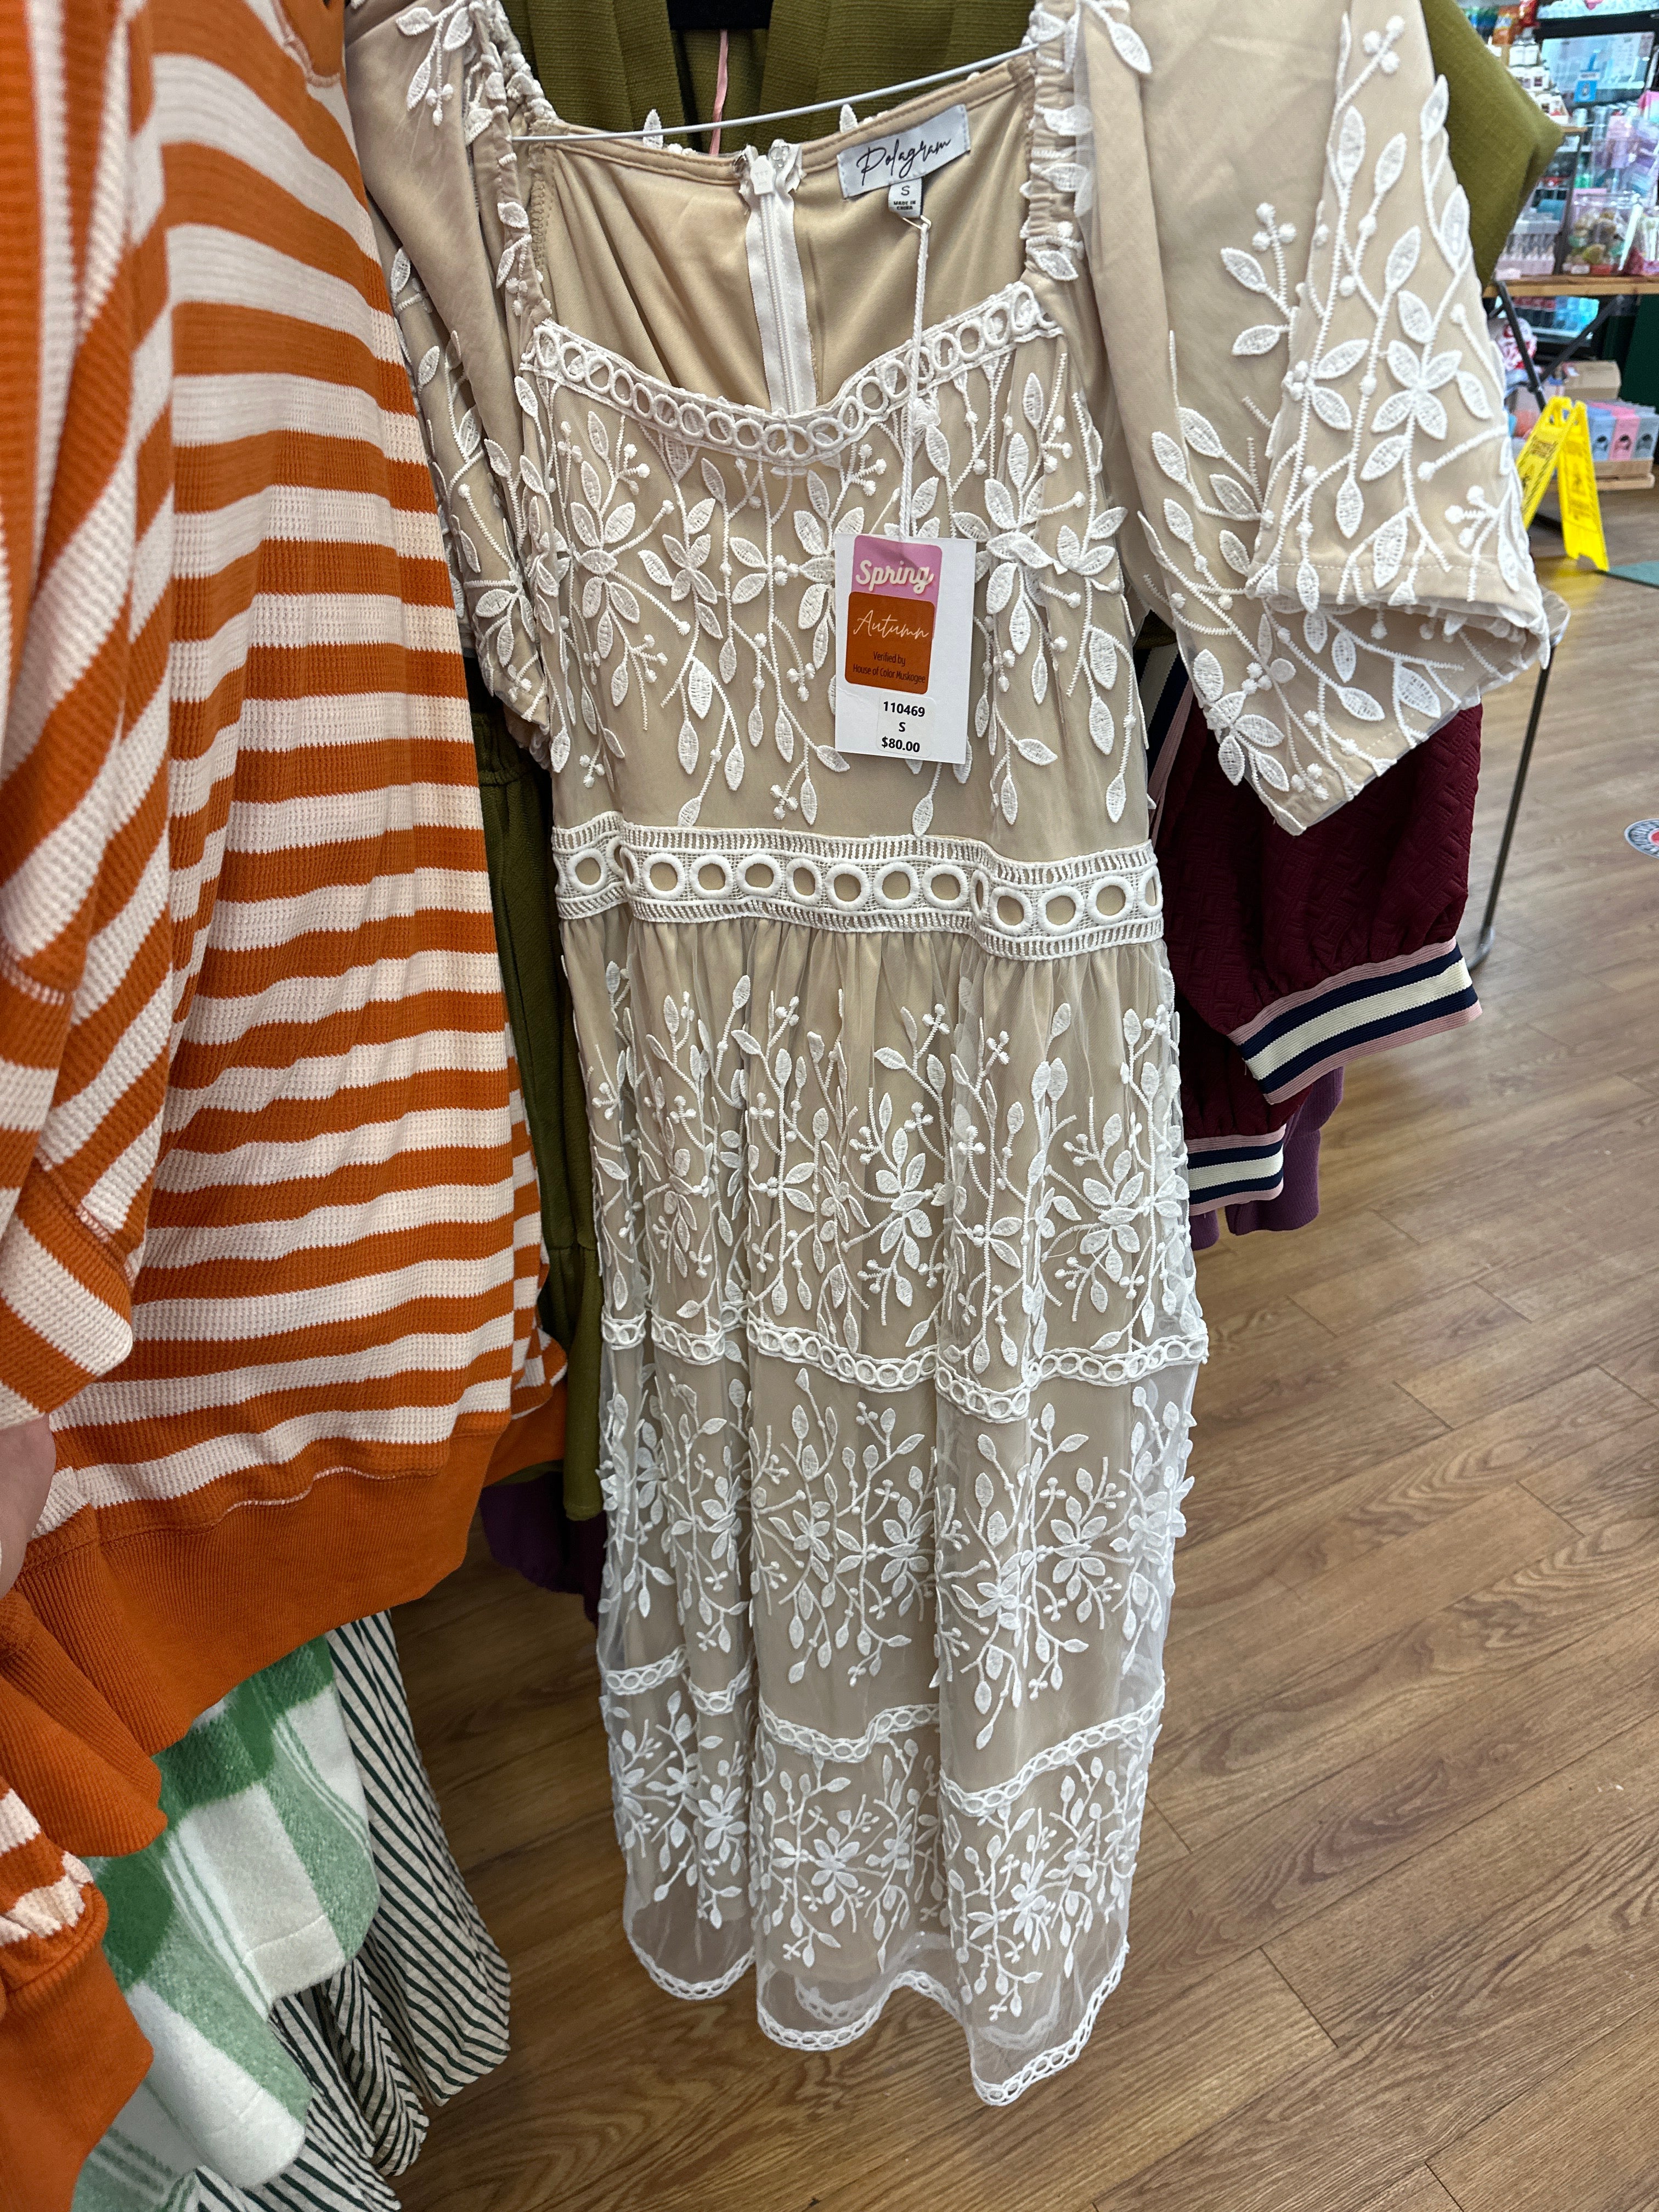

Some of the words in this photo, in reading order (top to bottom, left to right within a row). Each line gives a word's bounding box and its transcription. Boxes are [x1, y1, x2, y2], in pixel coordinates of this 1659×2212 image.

[856, 139, 951, 186] Polagram
[901, 185, 910, 196] S
[855, 560, 934, 594] Spring
[853, 610, 929, 640] Autumn
[873, 651, 896, 663] Verified
[898, 654, 906, 667] by
[853, 664, 871, 675] House
[872, 666, 879, 676] of
[880, 668, 895, 678] Color
[896, 670, 926, 685] Muskogee
[883, 701, 926, 717] 110469
[899, 722, 906, 732] S
[881, 736, 921, 753] $80.00
